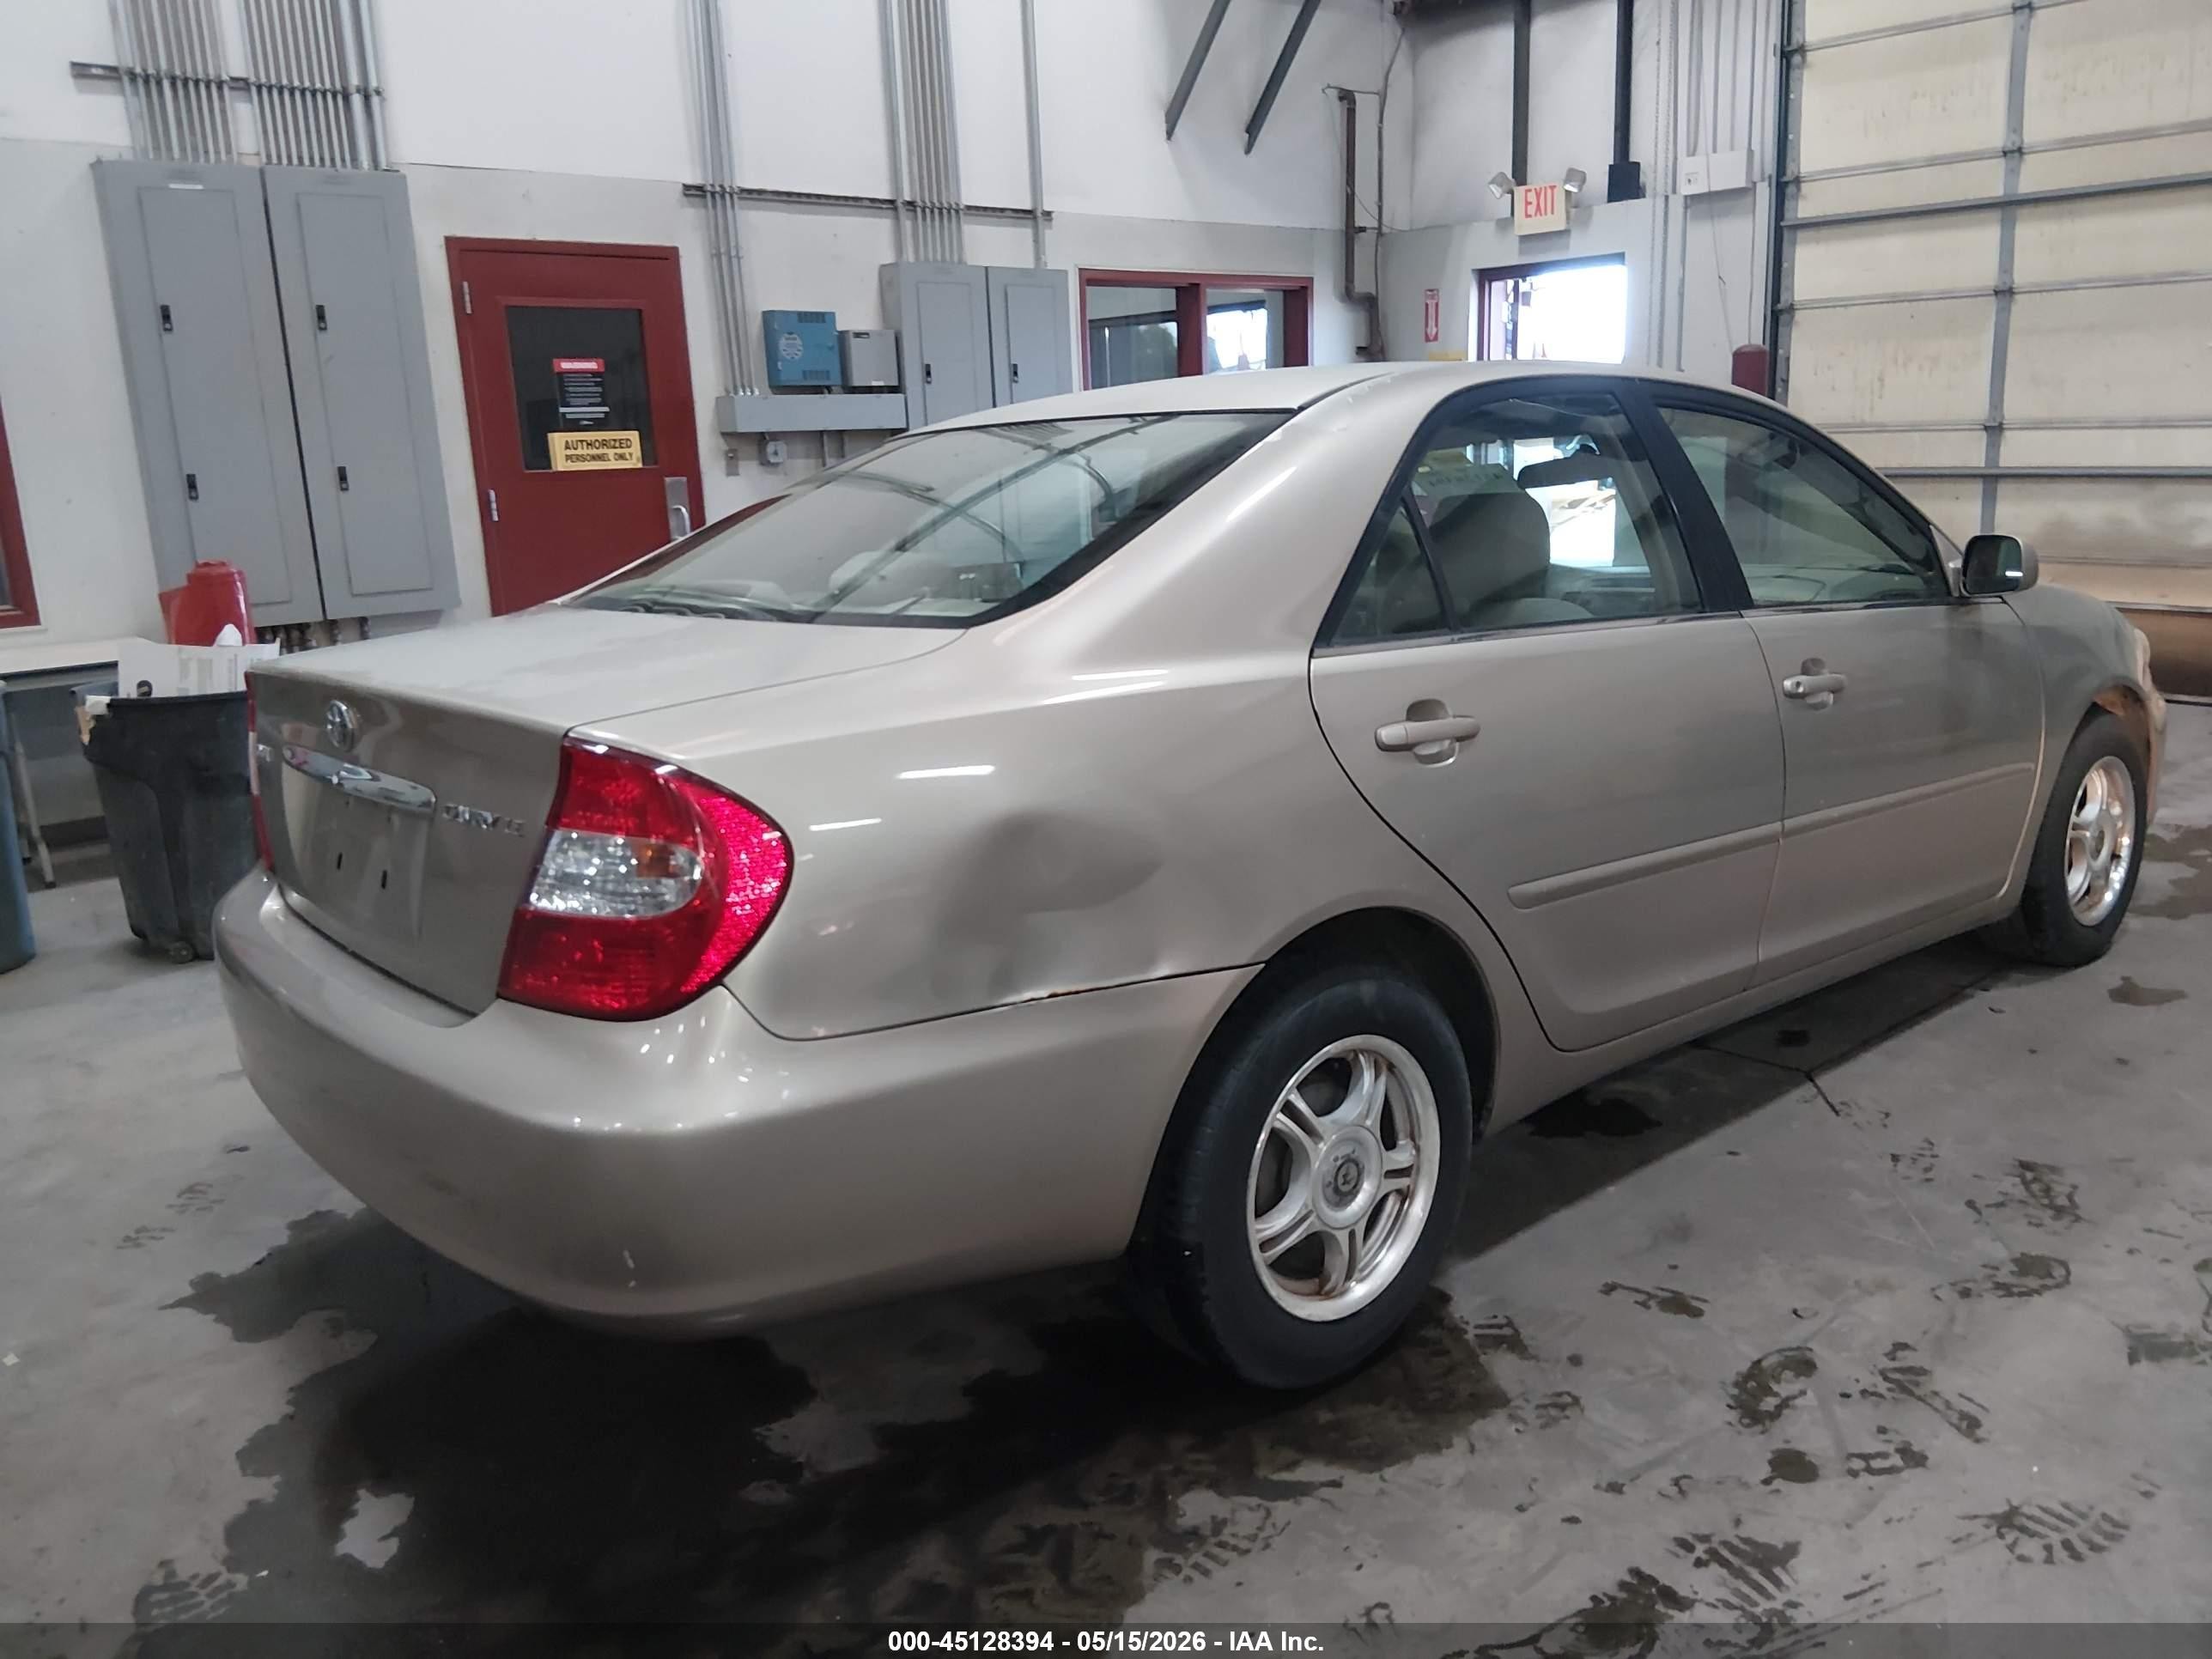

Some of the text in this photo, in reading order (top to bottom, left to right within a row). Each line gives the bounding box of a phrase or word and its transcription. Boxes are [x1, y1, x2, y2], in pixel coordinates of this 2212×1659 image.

[1524, 185, 1557, 219] EXIT
[564, 438, 633, 451] AUTHORIZED
[565, 452, 635, 464] PERSONNEL ONLY
